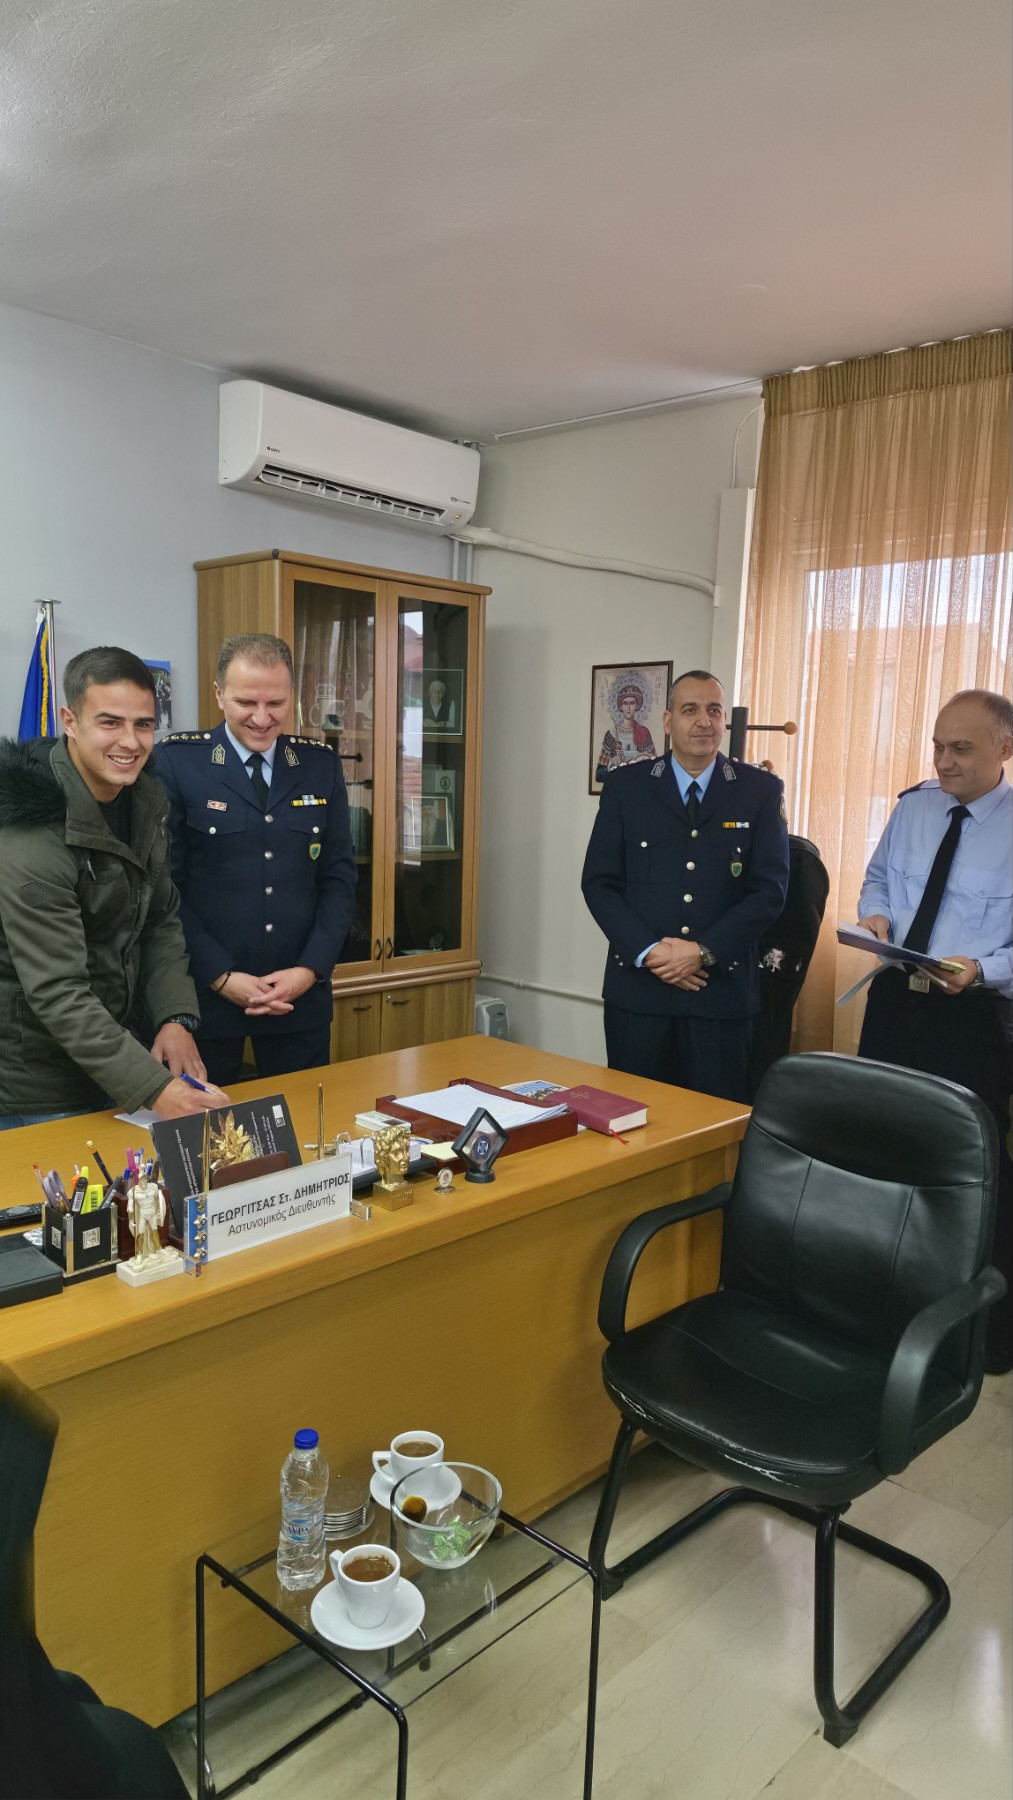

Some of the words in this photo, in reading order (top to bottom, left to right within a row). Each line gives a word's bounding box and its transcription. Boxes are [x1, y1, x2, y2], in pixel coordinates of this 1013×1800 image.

[211, 1195, 277, 1227] ΓΕΩΡΓΙΤΣΑΣ
[279, 1192, 292, 1205] Στ.
[294, 1172, 350, 1200] ΔΗΜΗΤΡΙΟΣ
[228, 1209, 287, 1237] Αστυνομικός
[288, 1194, 336, 1217] Διευθυντής
